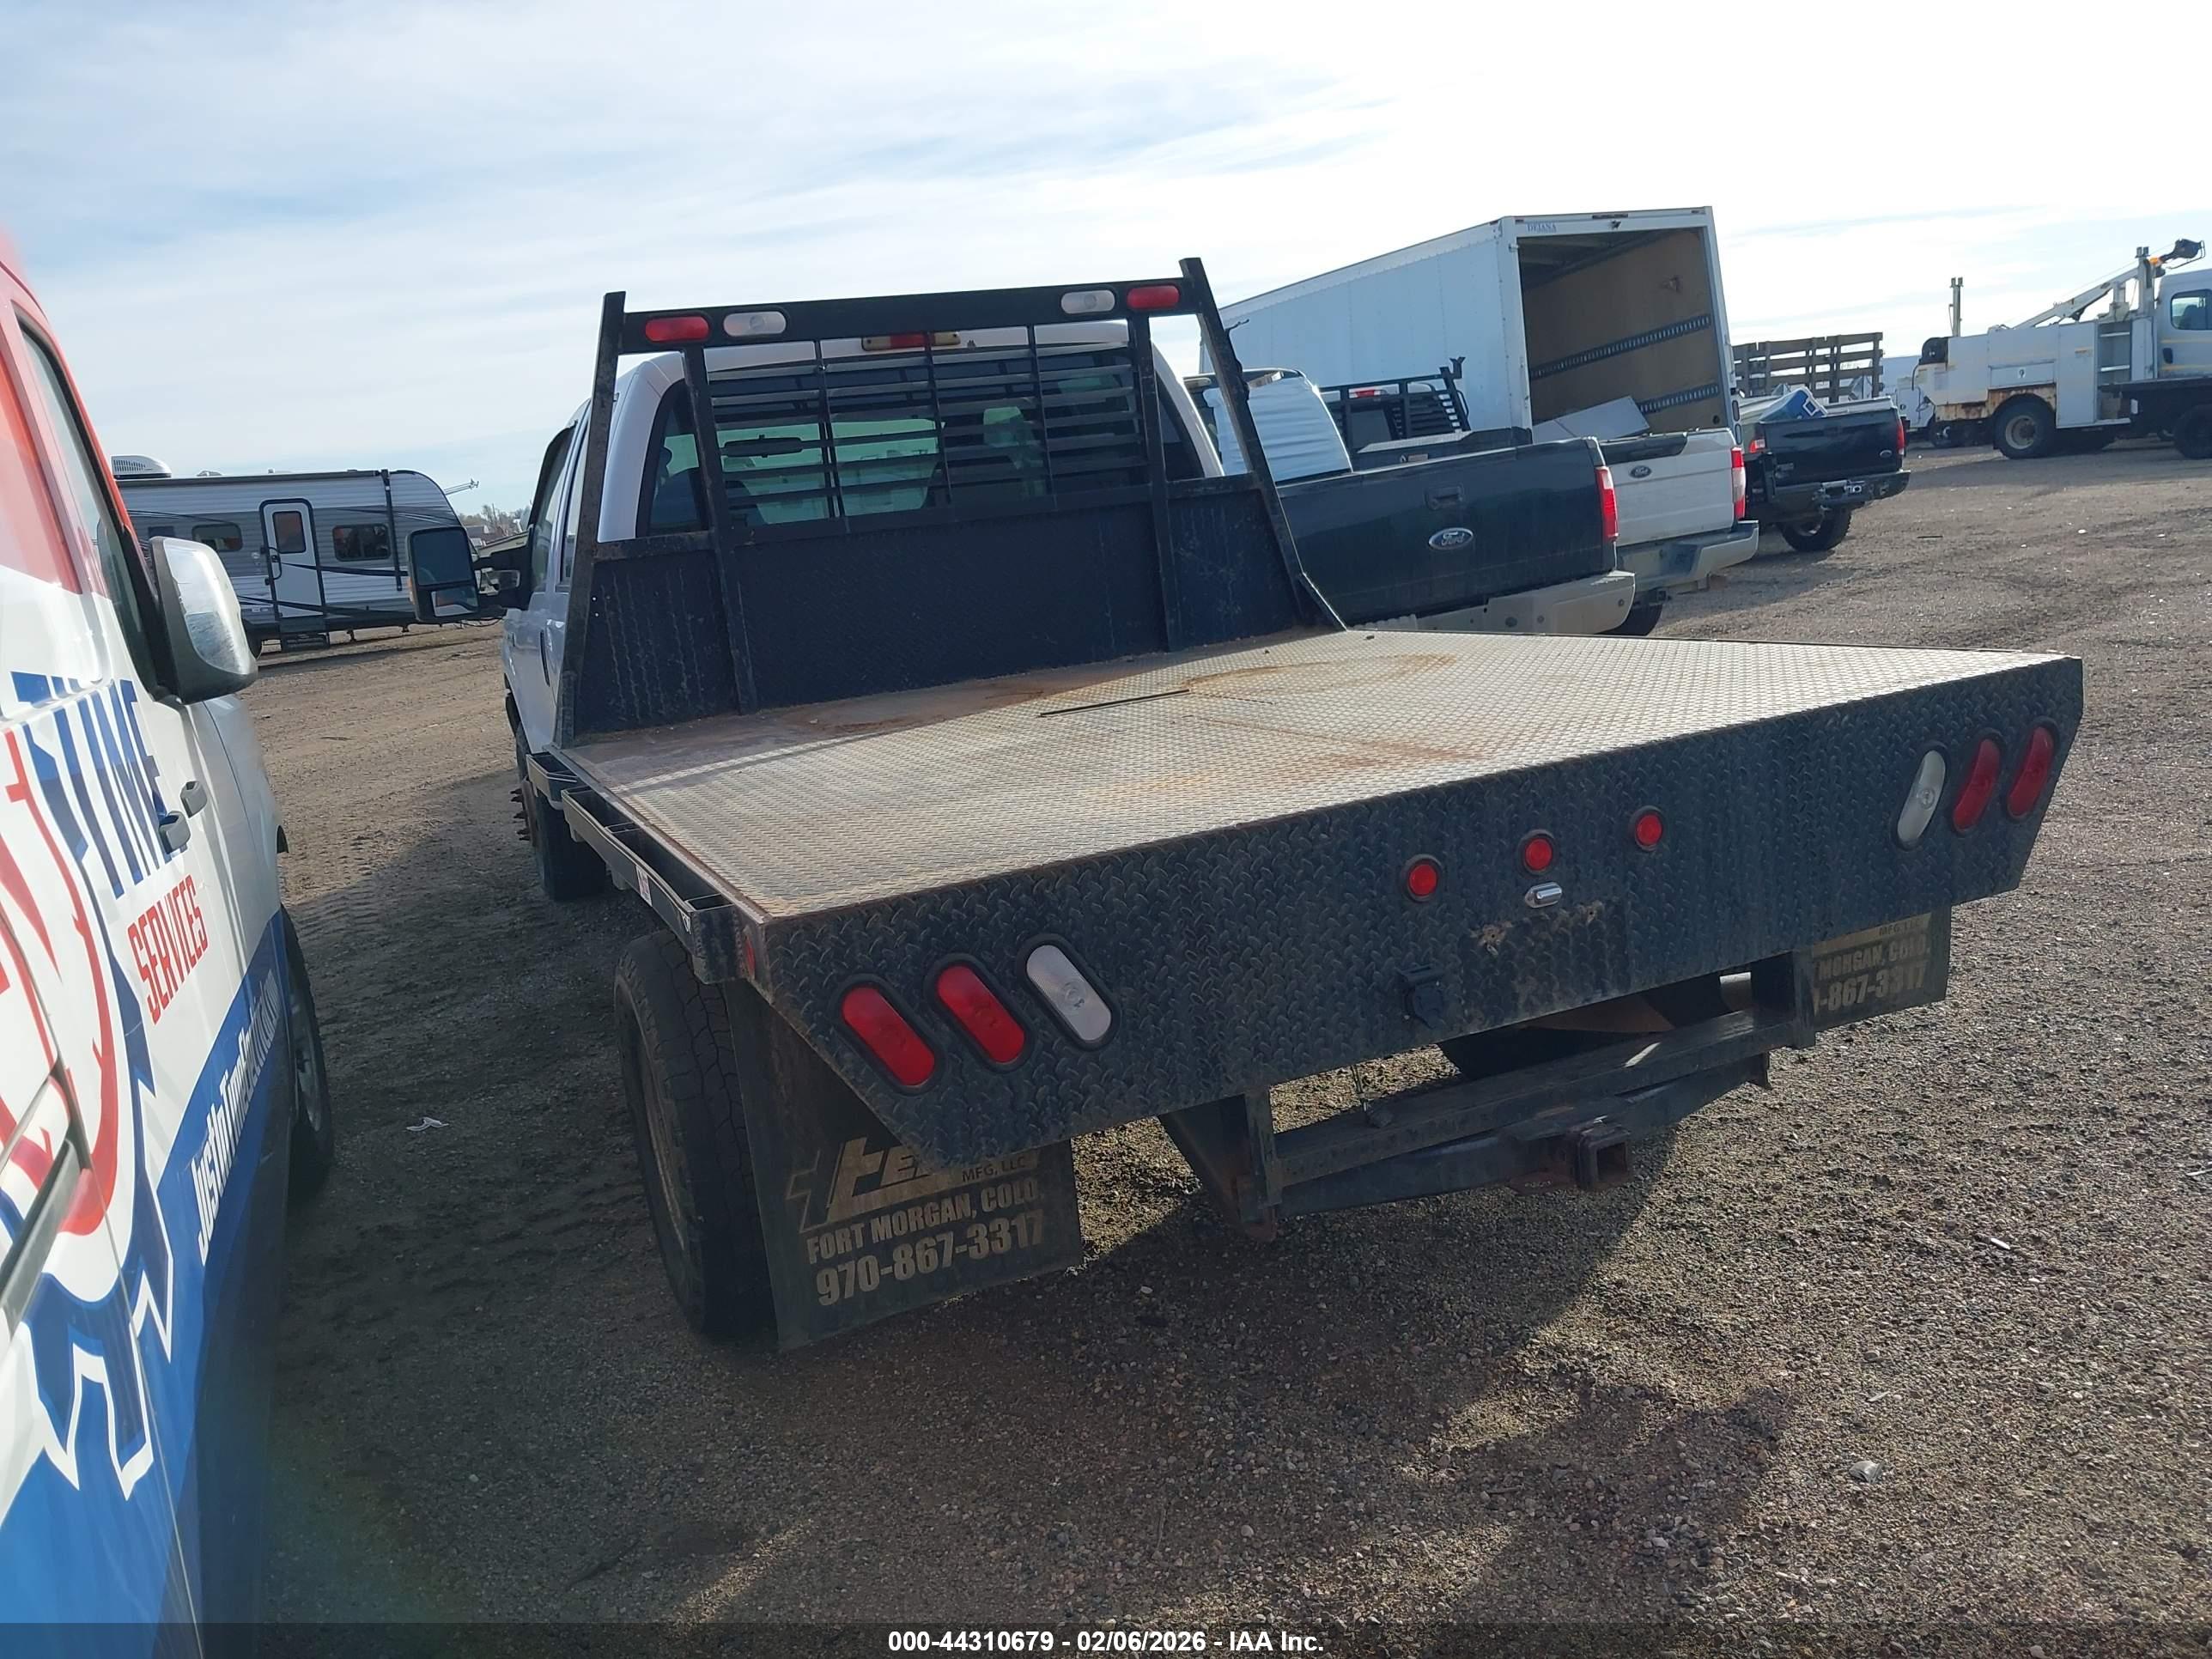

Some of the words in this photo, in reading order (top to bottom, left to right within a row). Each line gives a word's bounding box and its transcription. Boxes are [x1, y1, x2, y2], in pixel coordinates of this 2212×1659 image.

[126, 874, 208, 1025] SERVICES
[1000, 1156, 1027, 1172] LLC
[807, 1223, 865, 1265] FORT
[871, 1192, 977, 1244] MORGAN,
[981, 1177, 1045, 1212] COLO.
[816, 1208, 1045, 1307] 970-867-3317
